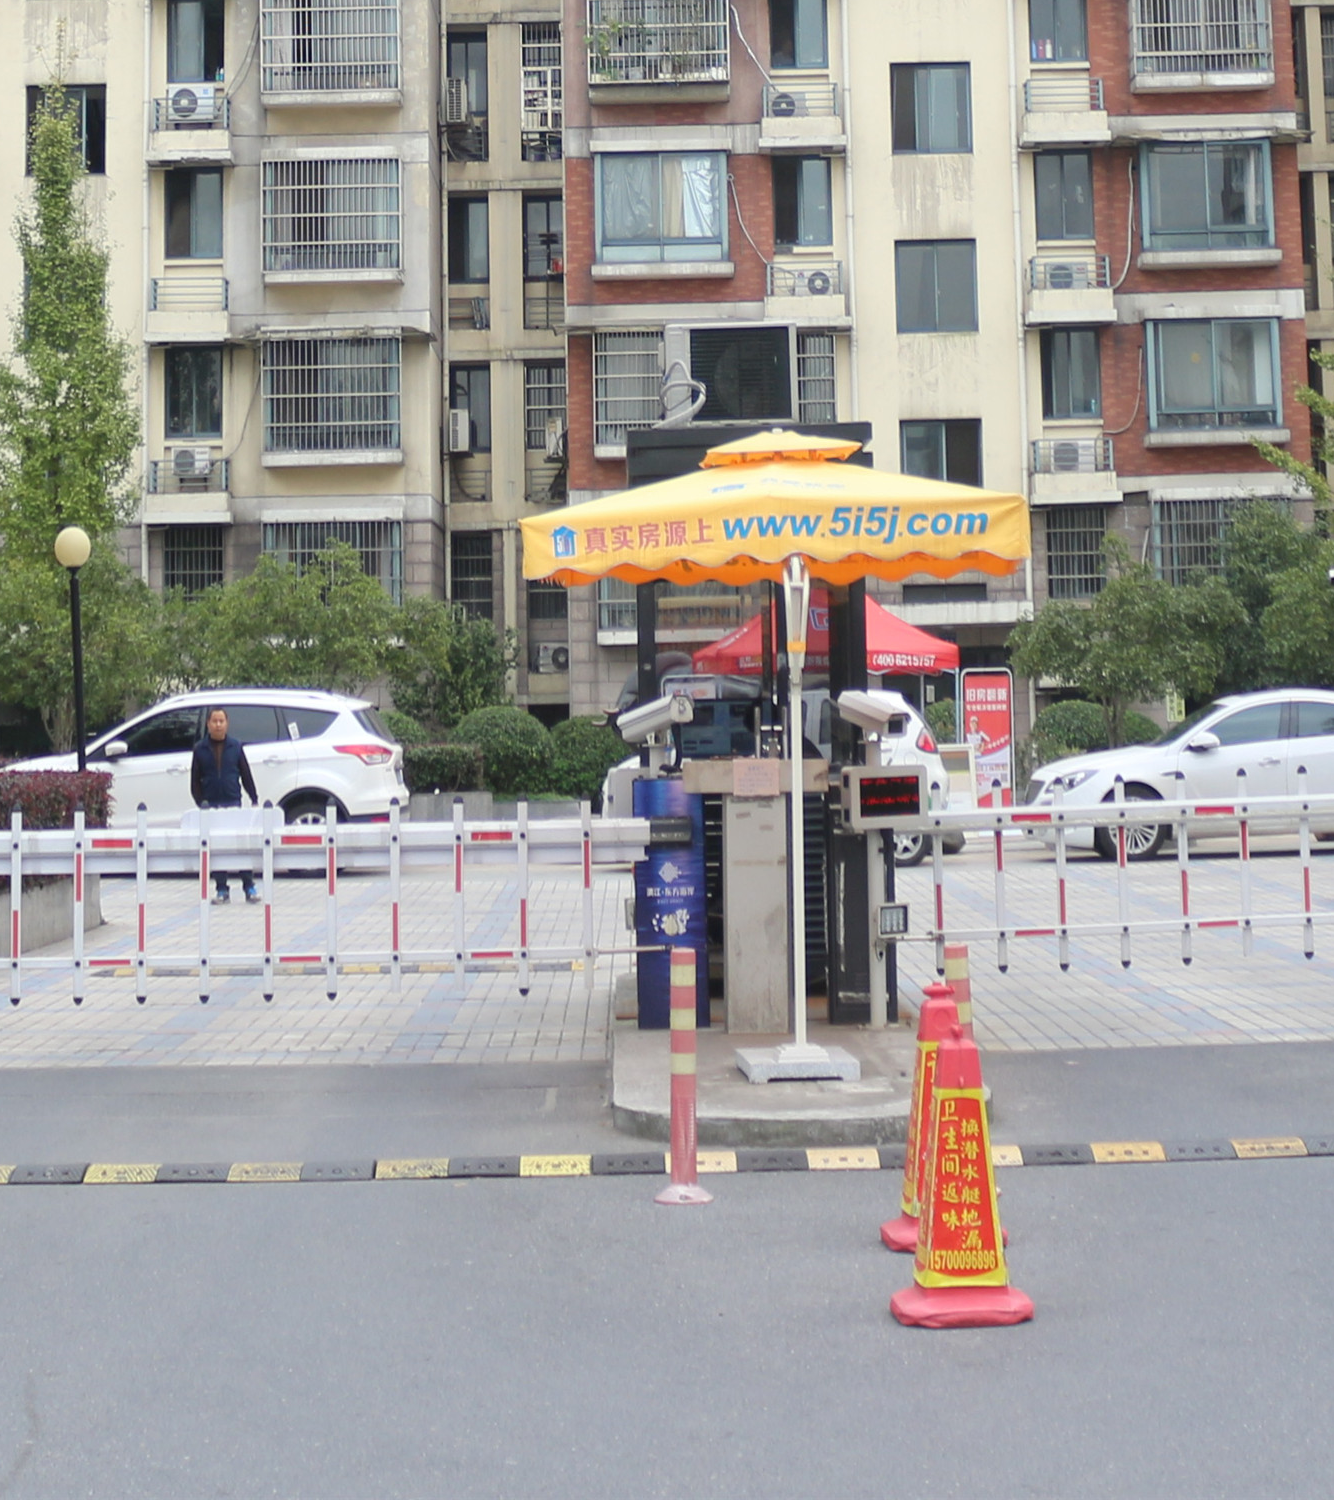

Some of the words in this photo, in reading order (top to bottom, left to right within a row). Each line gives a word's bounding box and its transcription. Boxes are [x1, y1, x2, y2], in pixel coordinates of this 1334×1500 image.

[583, 517, 714, 554] 真实房源上
[722, 505, 989, 544] www.5i5j.com
[941, 1100, 961, 1231] 卫生间返味
[960, 1118, 982, 1250] 换潜水艇地漏
[930, 1250, 995, 1270] 15700096896
